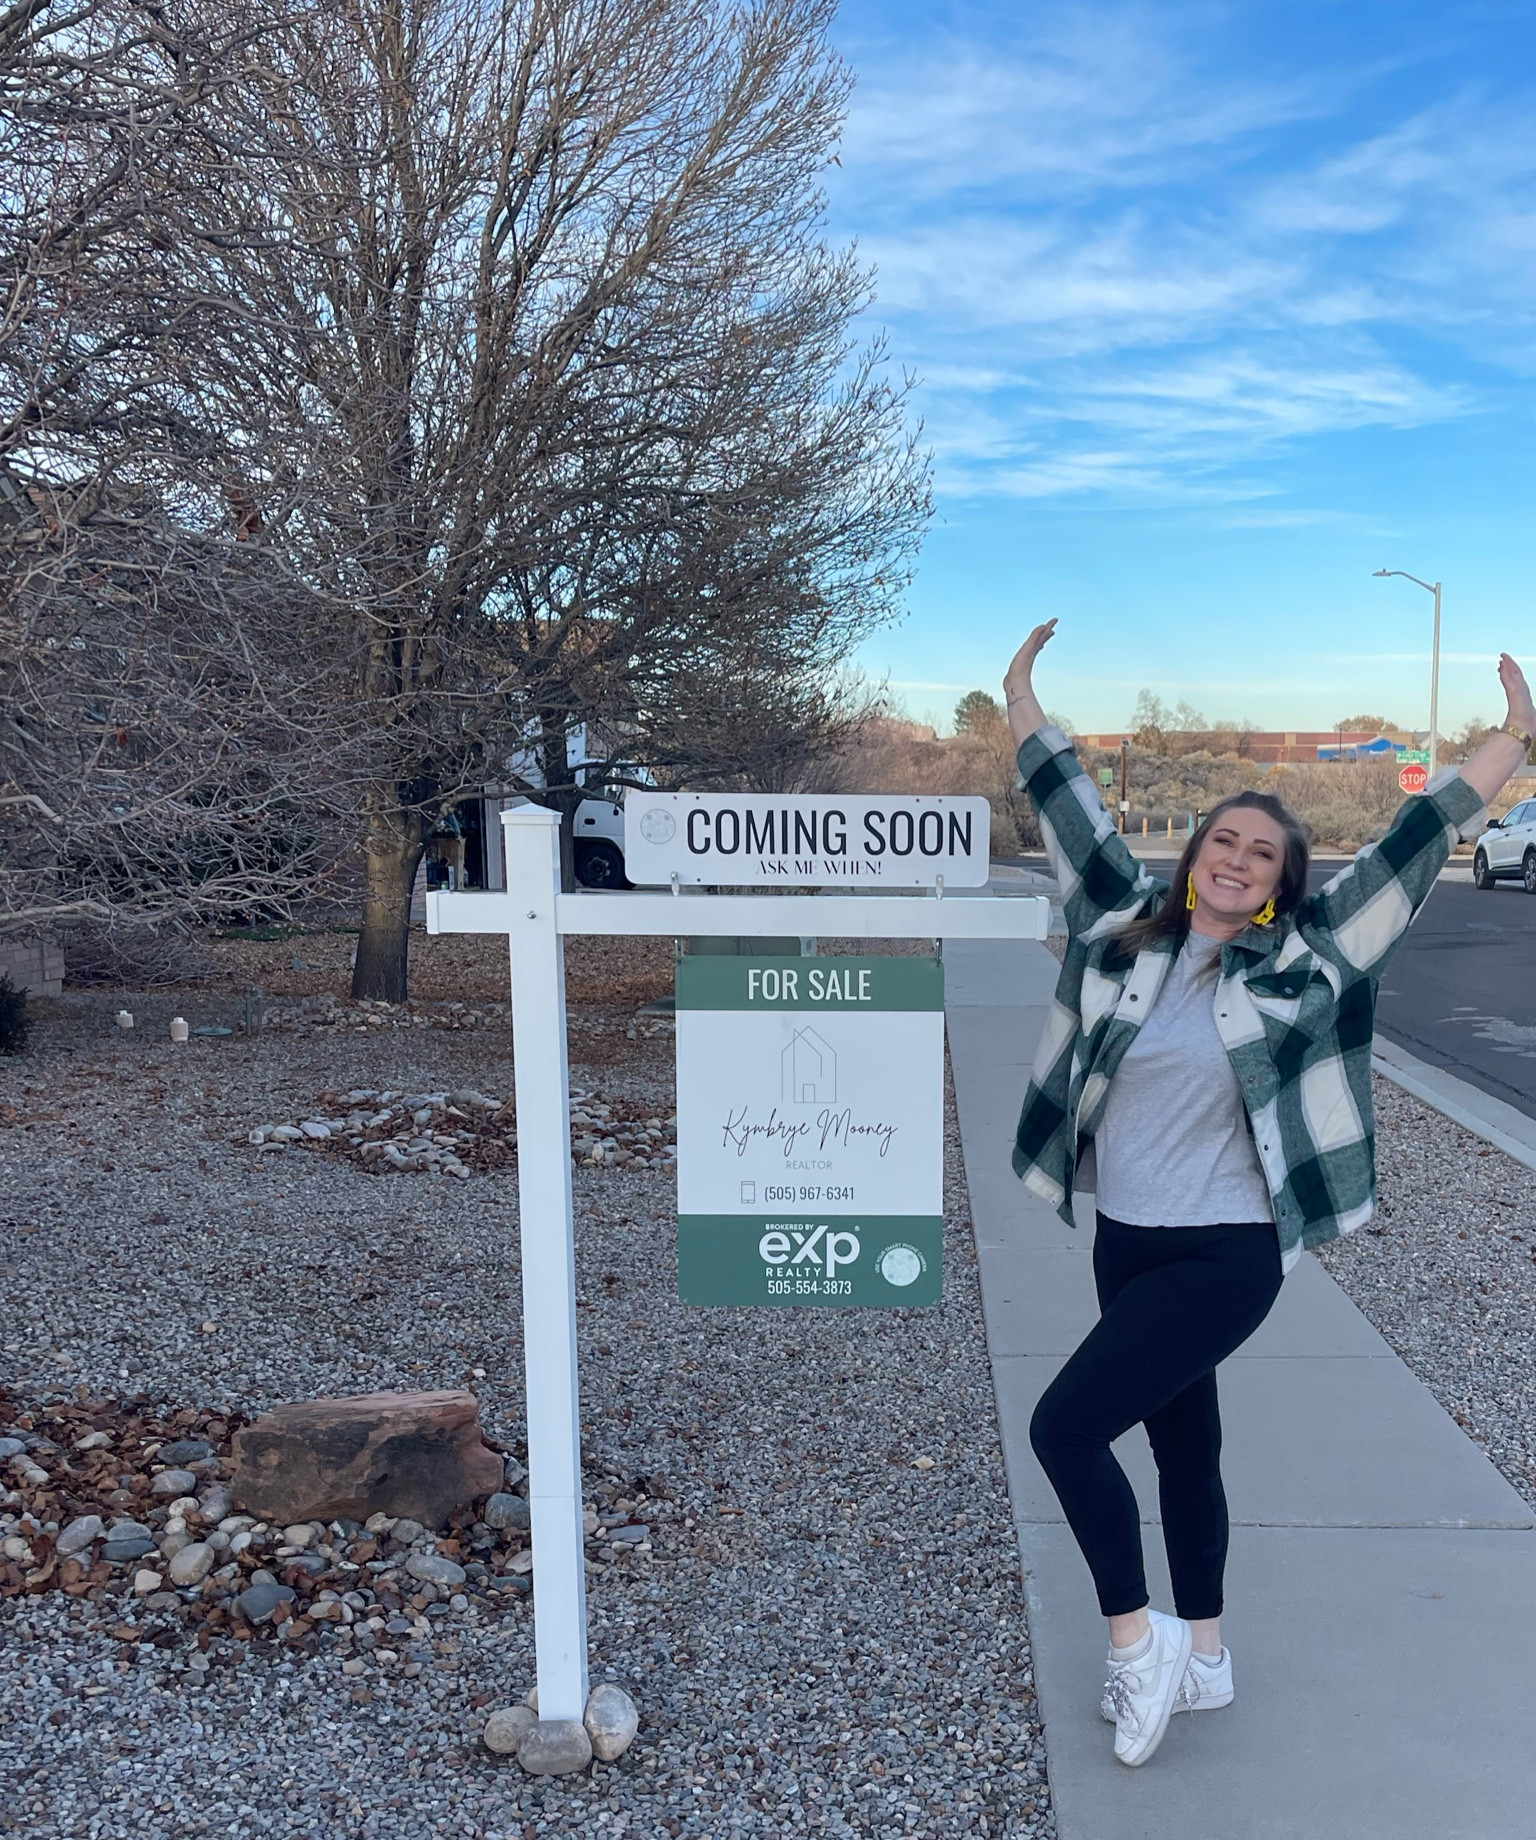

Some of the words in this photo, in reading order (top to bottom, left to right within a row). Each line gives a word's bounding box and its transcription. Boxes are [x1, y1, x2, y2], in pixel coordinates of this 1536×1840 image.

[1401, 773, 1427, 785] STOP
[687, 809, 847, 856] COMING
[863, 810, 972, 857] SOON
[756, 860, 788, 875] ASK
[795, 860, 818, 875] ME
[823, 860, 882, 875] WHEN!
[748, 969, 798, 1001] FOR
[808, 969, 872, 1001] SALE
[722, 1105, 810, 1157] Kymbrye
[816, 1108, 898, 1158] Mooney
[786, 1160, 833, 1170] REALTOR
[764, 1186, 796, 1203] (505)
[799, 1186, 855, 1201] 967-6341
[765, 1223, 804, 1231] BROKERED
[805, 1223, 814, 1231] BY
[765, 1267, 822, 1278] REALTY
[767, 1280, 852, 1295] 505-554-3873
